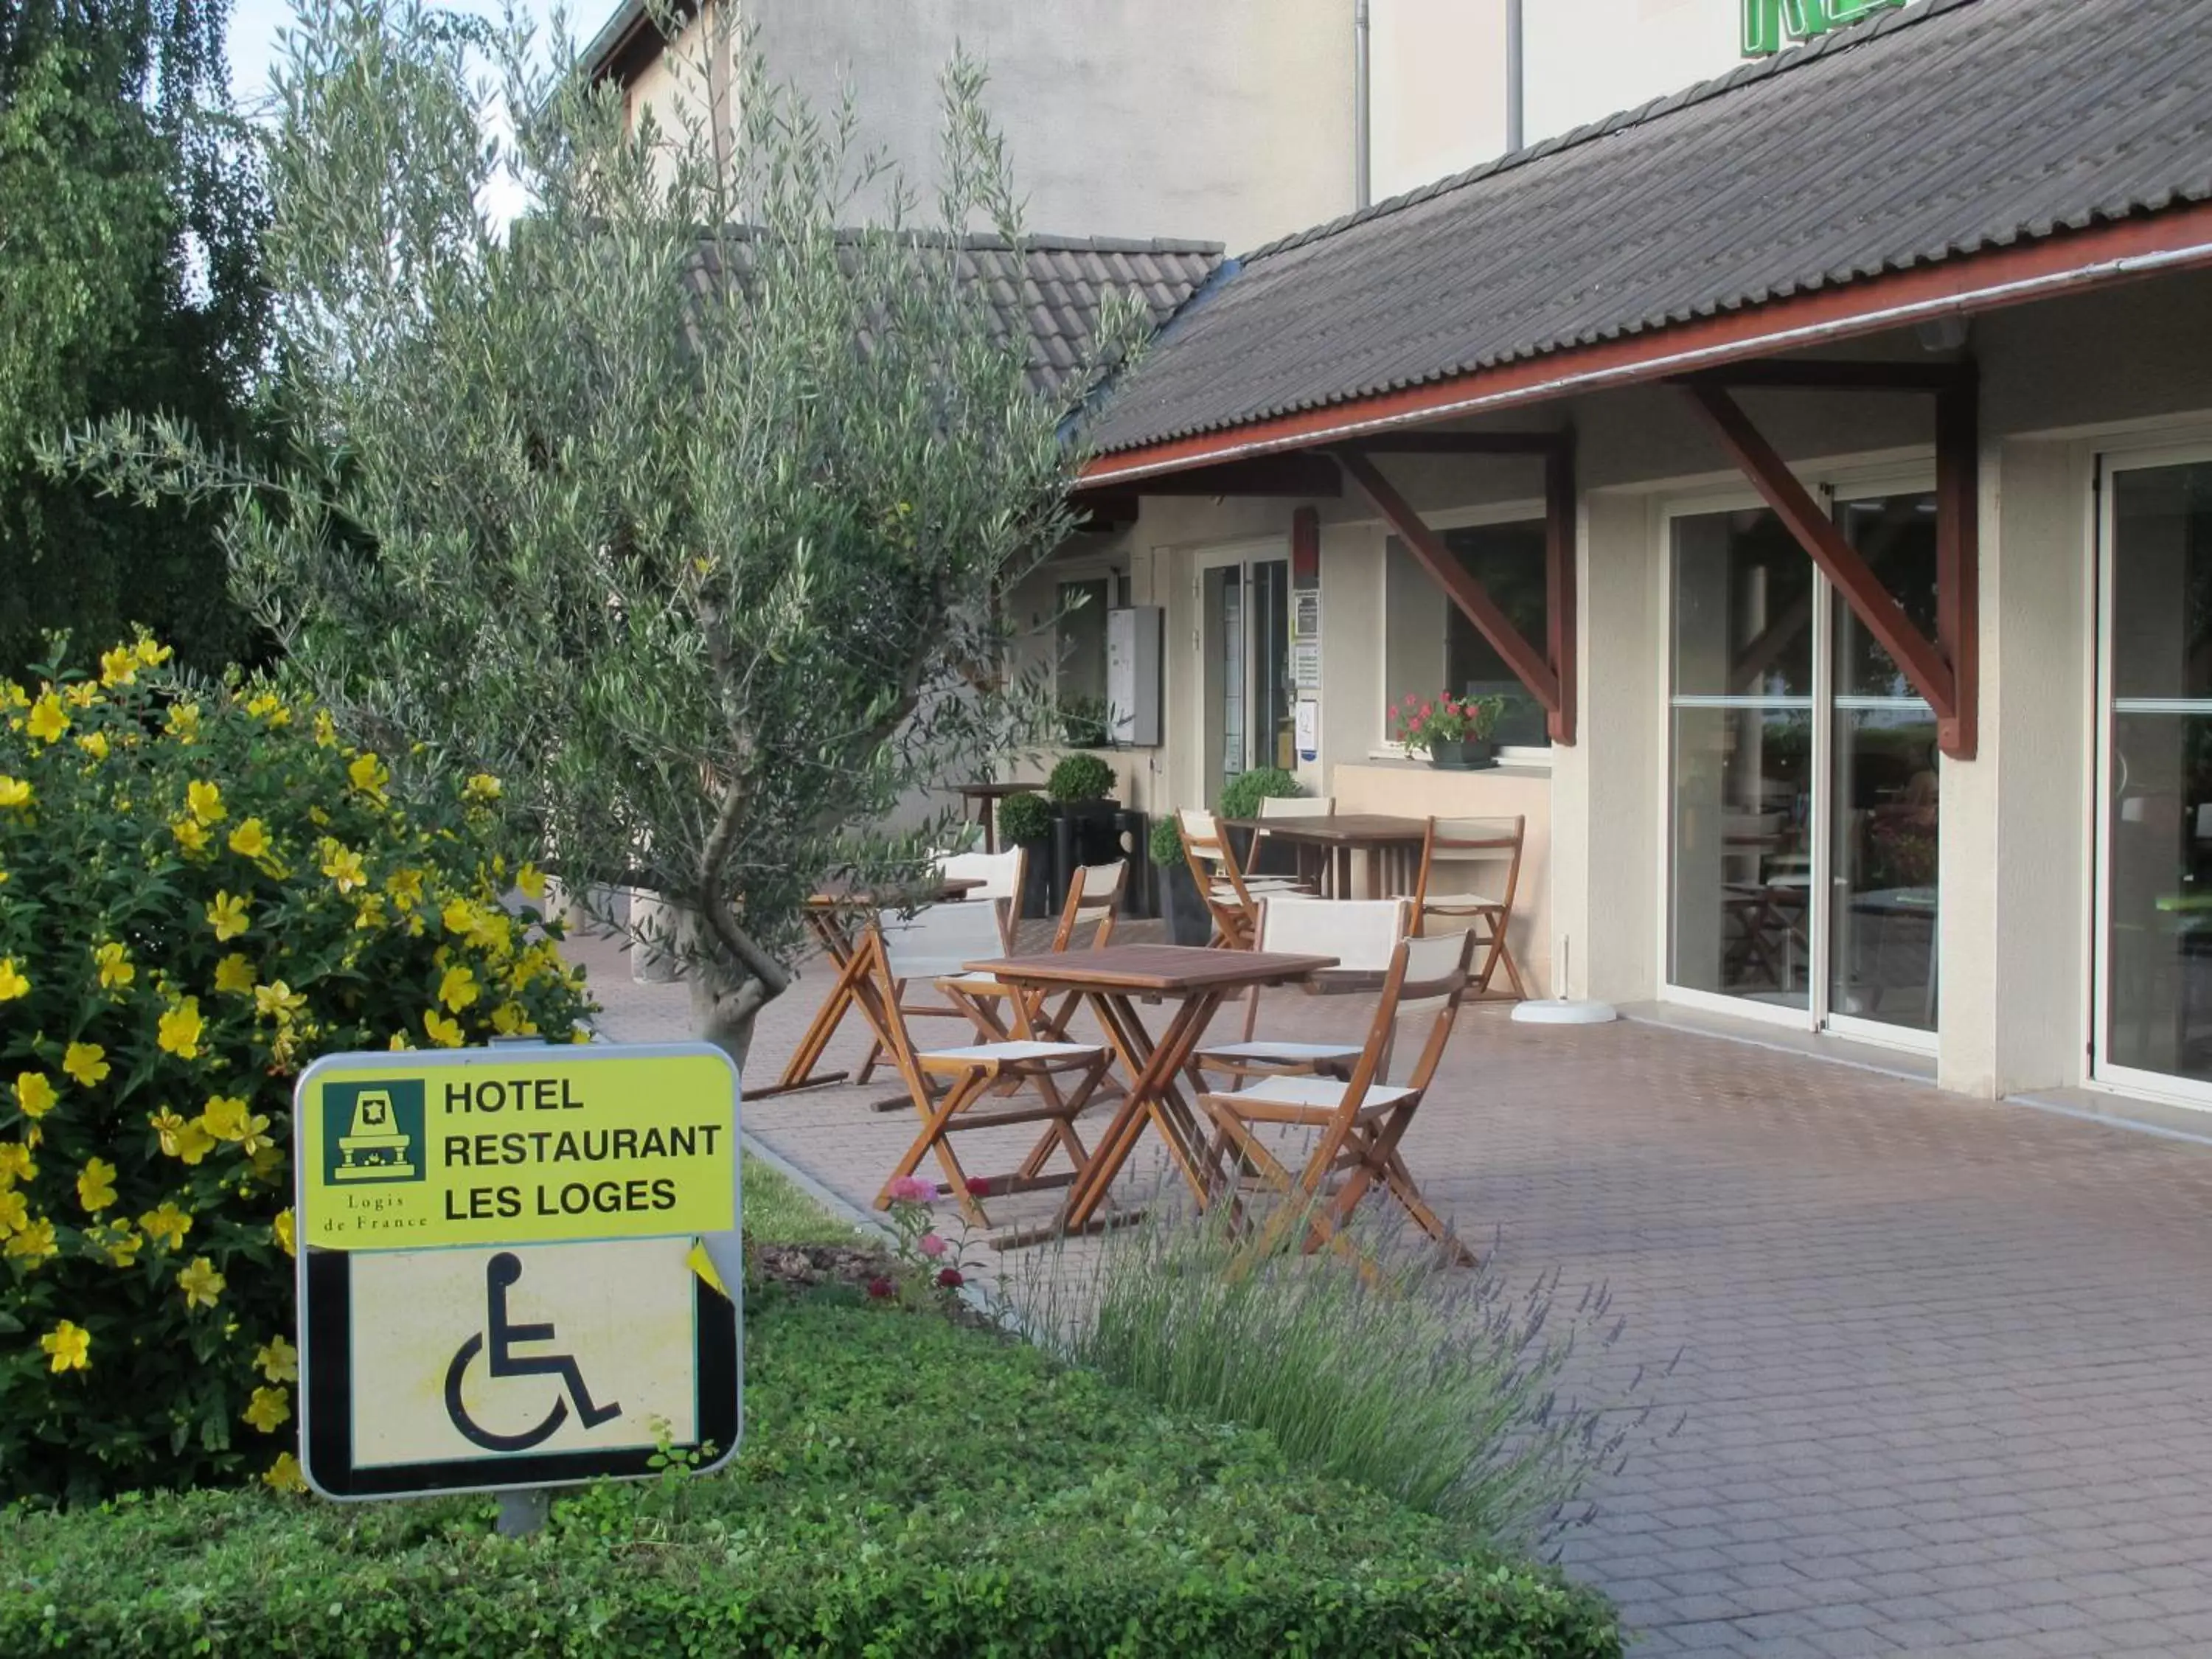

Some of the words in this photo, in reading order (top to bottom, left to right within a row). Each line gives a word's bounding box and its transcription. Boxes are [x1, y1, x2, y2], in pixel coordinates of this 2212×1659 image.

[444, 1079, 584, 1113] HOTEL
[444, 1124, 722, 1167] RESTAURANT
[348, 1193, 403, 1211] Logis
[445, 1185, 521, 1220] LES
[537, 1179, 676, 1216] LOGES
[323, 1217, 345, 1231] de
[356, 1215, 428, 1229] France
